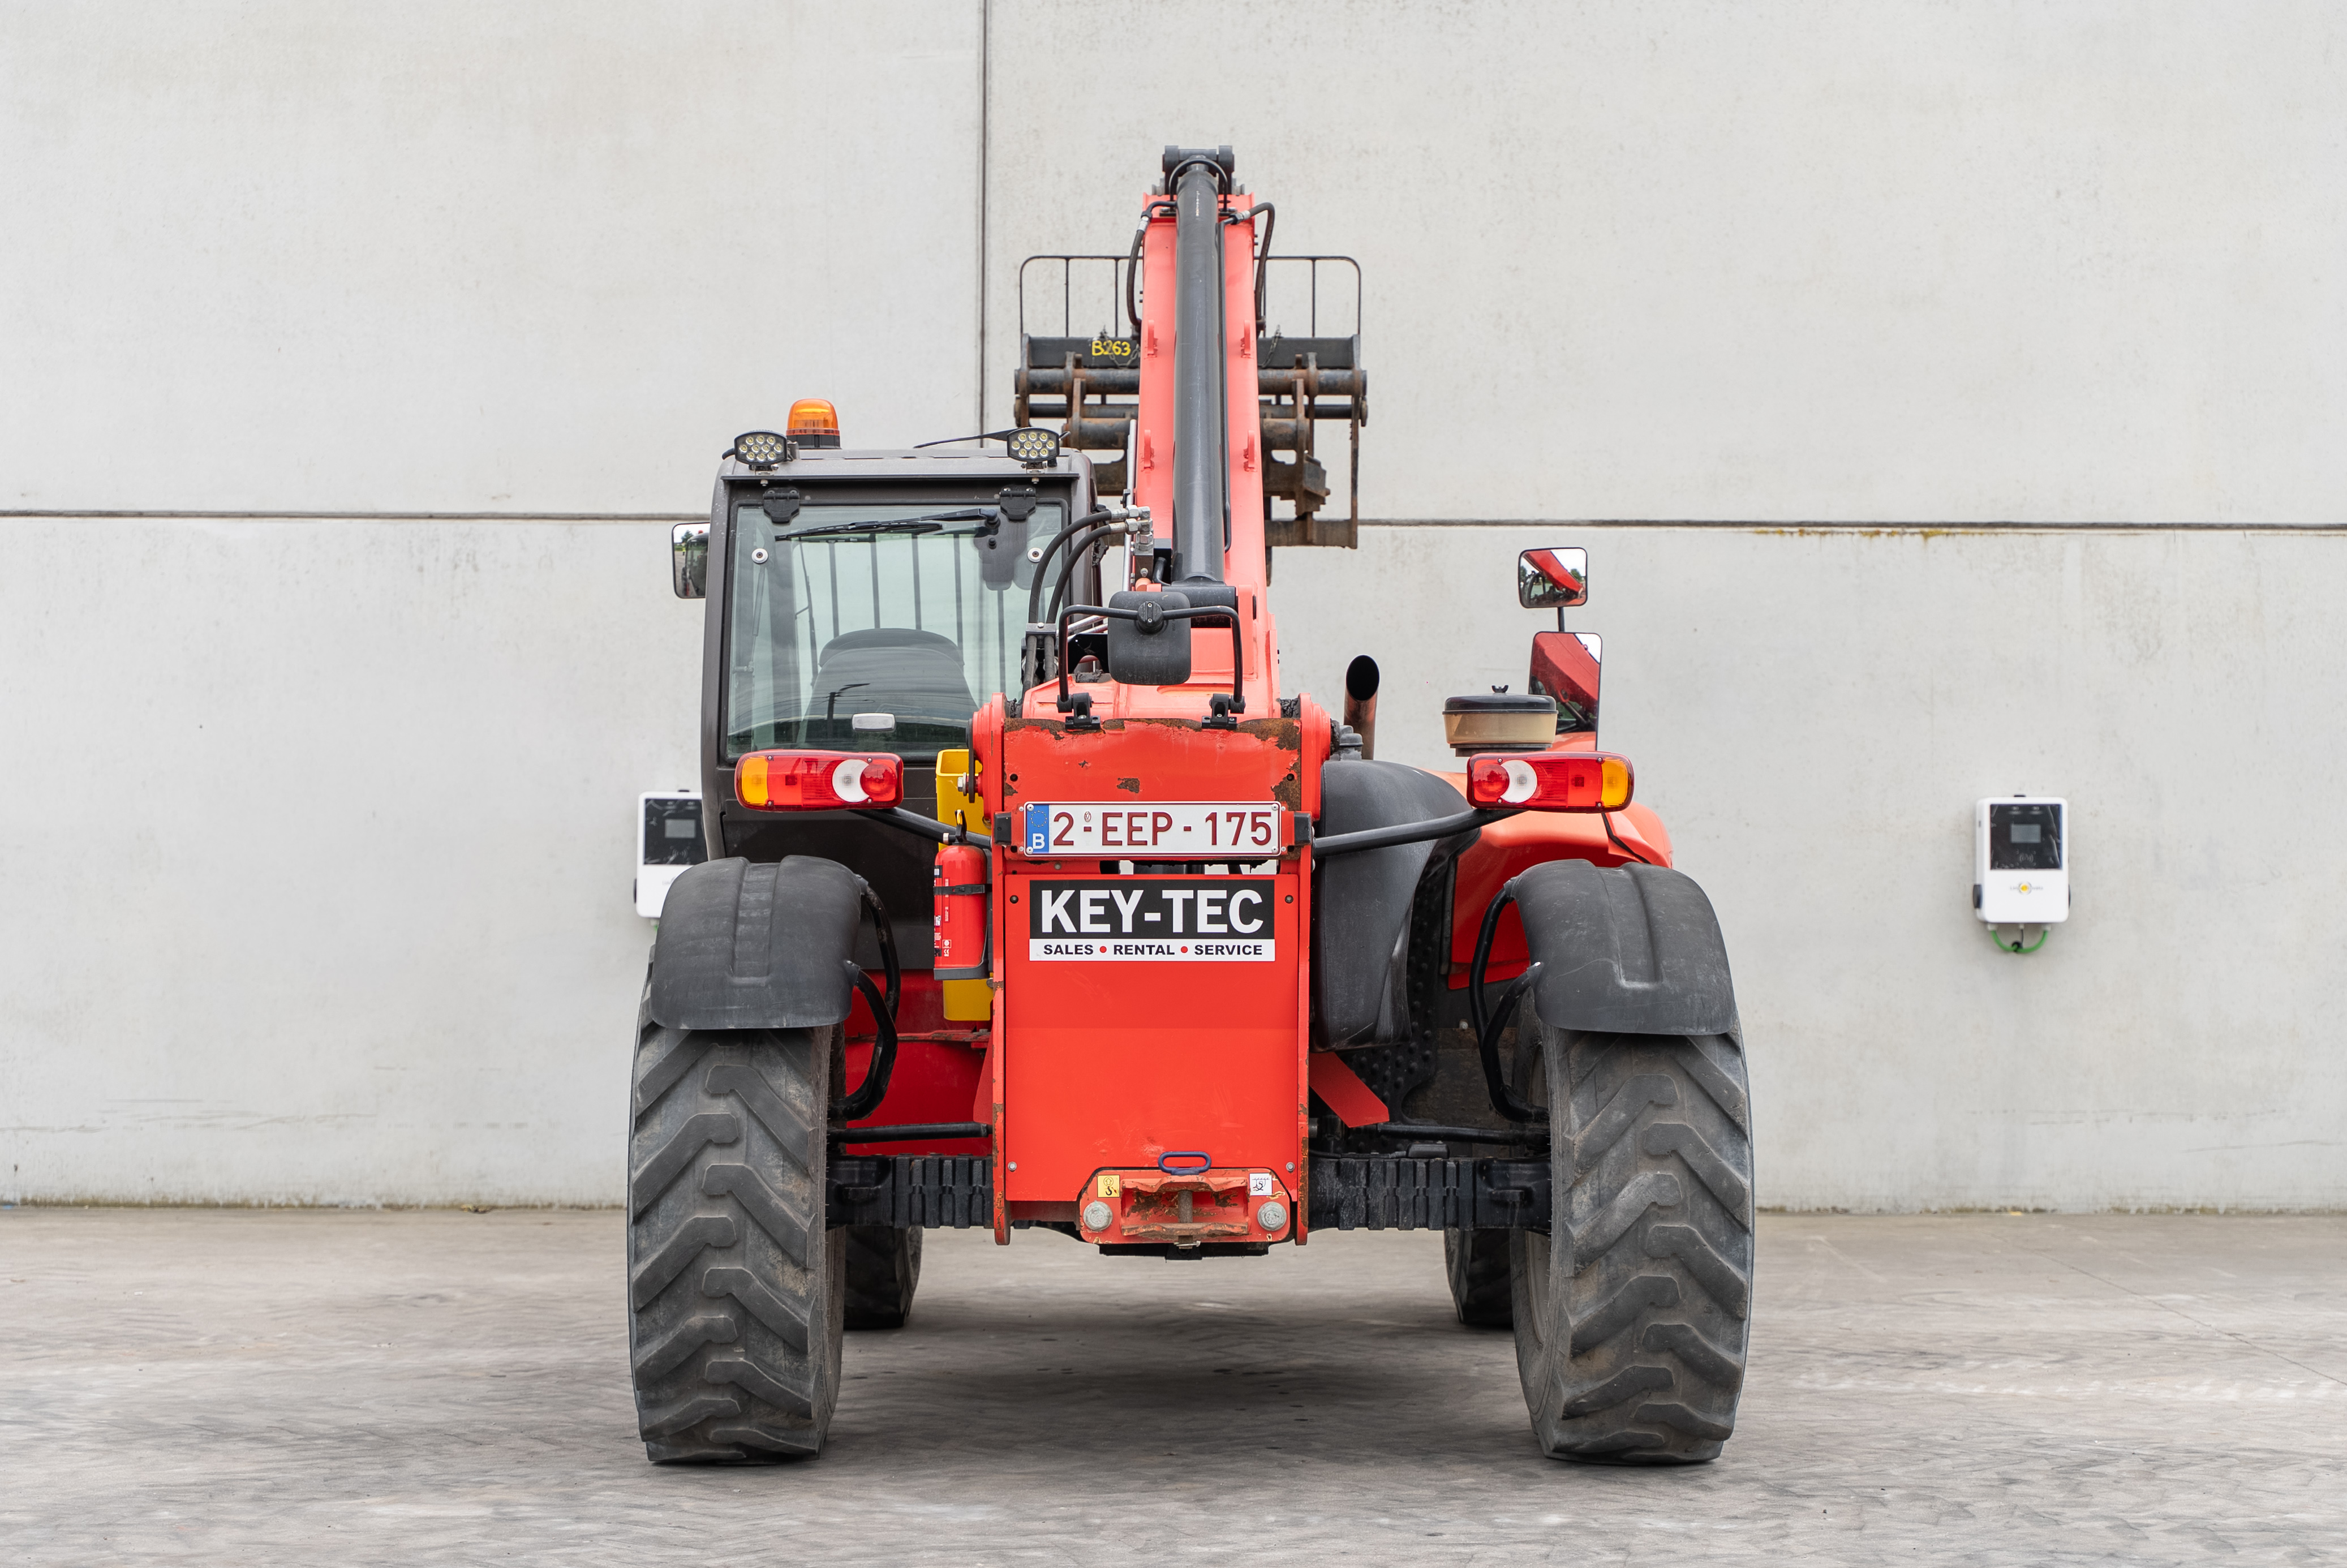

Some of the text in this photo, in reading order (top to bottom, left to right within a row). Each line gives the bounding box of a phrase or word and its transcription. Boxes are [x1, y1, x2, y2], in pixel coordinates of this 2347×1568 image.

[1092, 340, 1131, 356] B263
[1033, 833, 1045, 849] B
[1041, 889, 1264, 934] KEY-TEC
[1043, 944, 1263, 955] SALES RENTAL SERVICE
